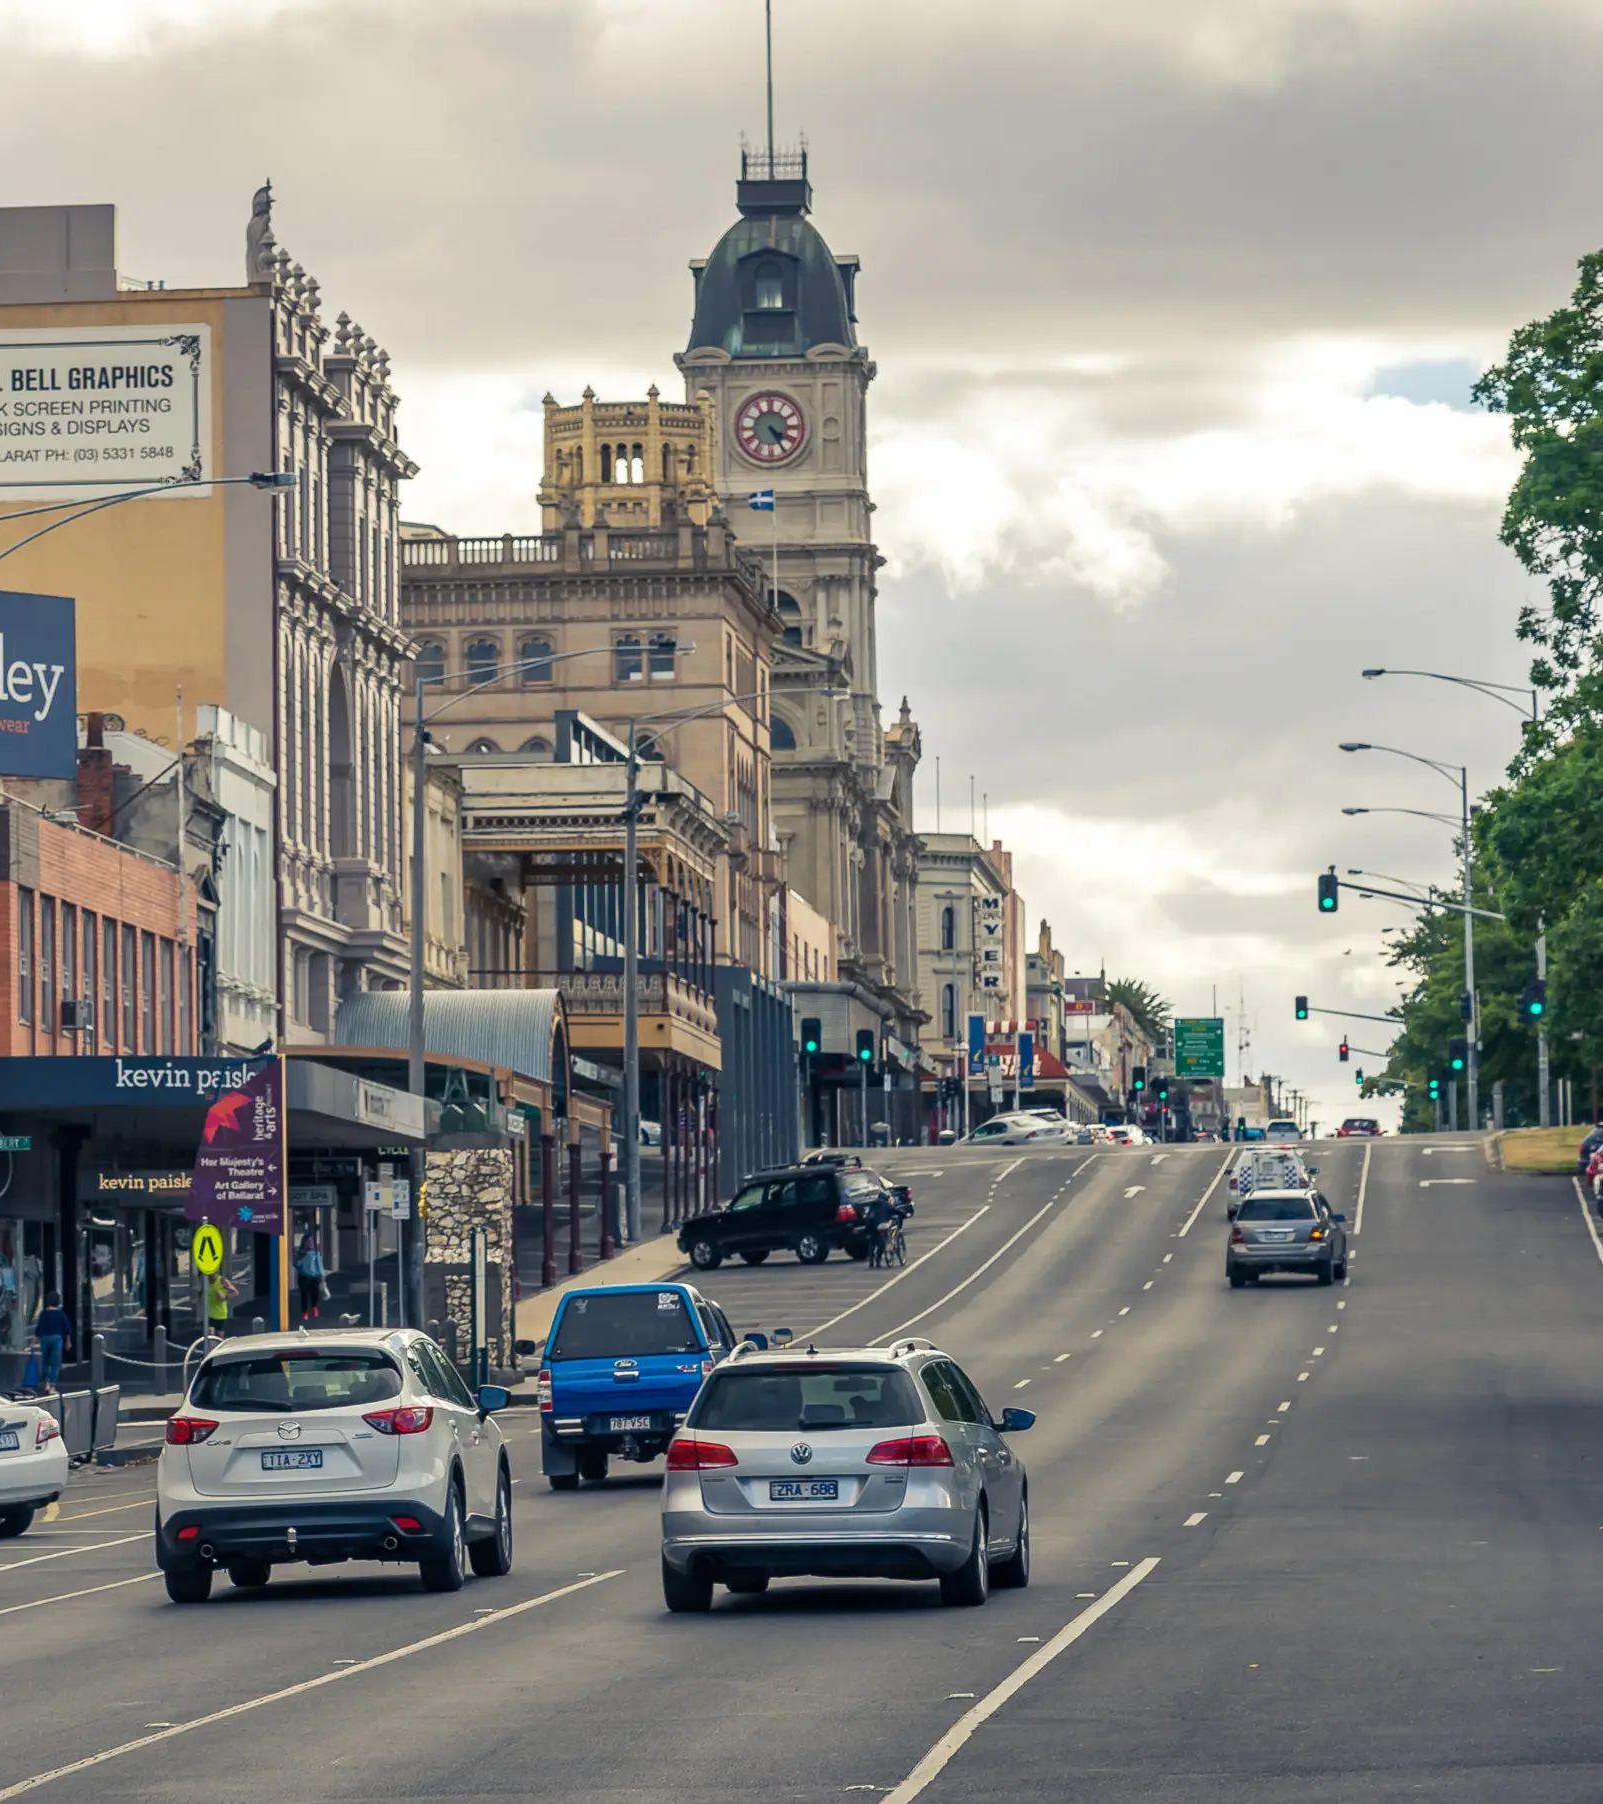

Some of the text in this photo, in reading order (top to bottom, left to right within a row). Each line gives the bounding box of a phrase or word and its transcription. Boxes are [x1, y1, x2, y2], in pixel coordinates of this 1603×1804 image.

[11, 367, 63, 393] BELL
[68, 364, 174, 391] GRAPHICS
[13, 400, 84, 417] SCREEN
[89, 398, 172, 415] PRINTING
[50, 421, 63, 436] &
[67, 418, 151, 436] DISPLAYS
[45, 449, 70, 462] PH:
[73, 447, 99, 463] (03)
[102, 447, 136, 461] 5331
[140, 446, 174, 460] 5848
[982, 897, 999, 988] MYER
[114, 1058, 258, 1095] kevin paisl
[252, 1095, 265, 1141] heritage
[265, 1106, 277, 1132] arts
[200, 1157, 264, 1169] Her Majesty's
[227, 1168, 264, 1177] Theatre
[98, 1173, 145, 1190] kevin
[148, 1171, 193, 1193] paisle
[214, 1181, 264, 1192] Art Gallery
[216, 1191, 264, 1200] of Ballarat
